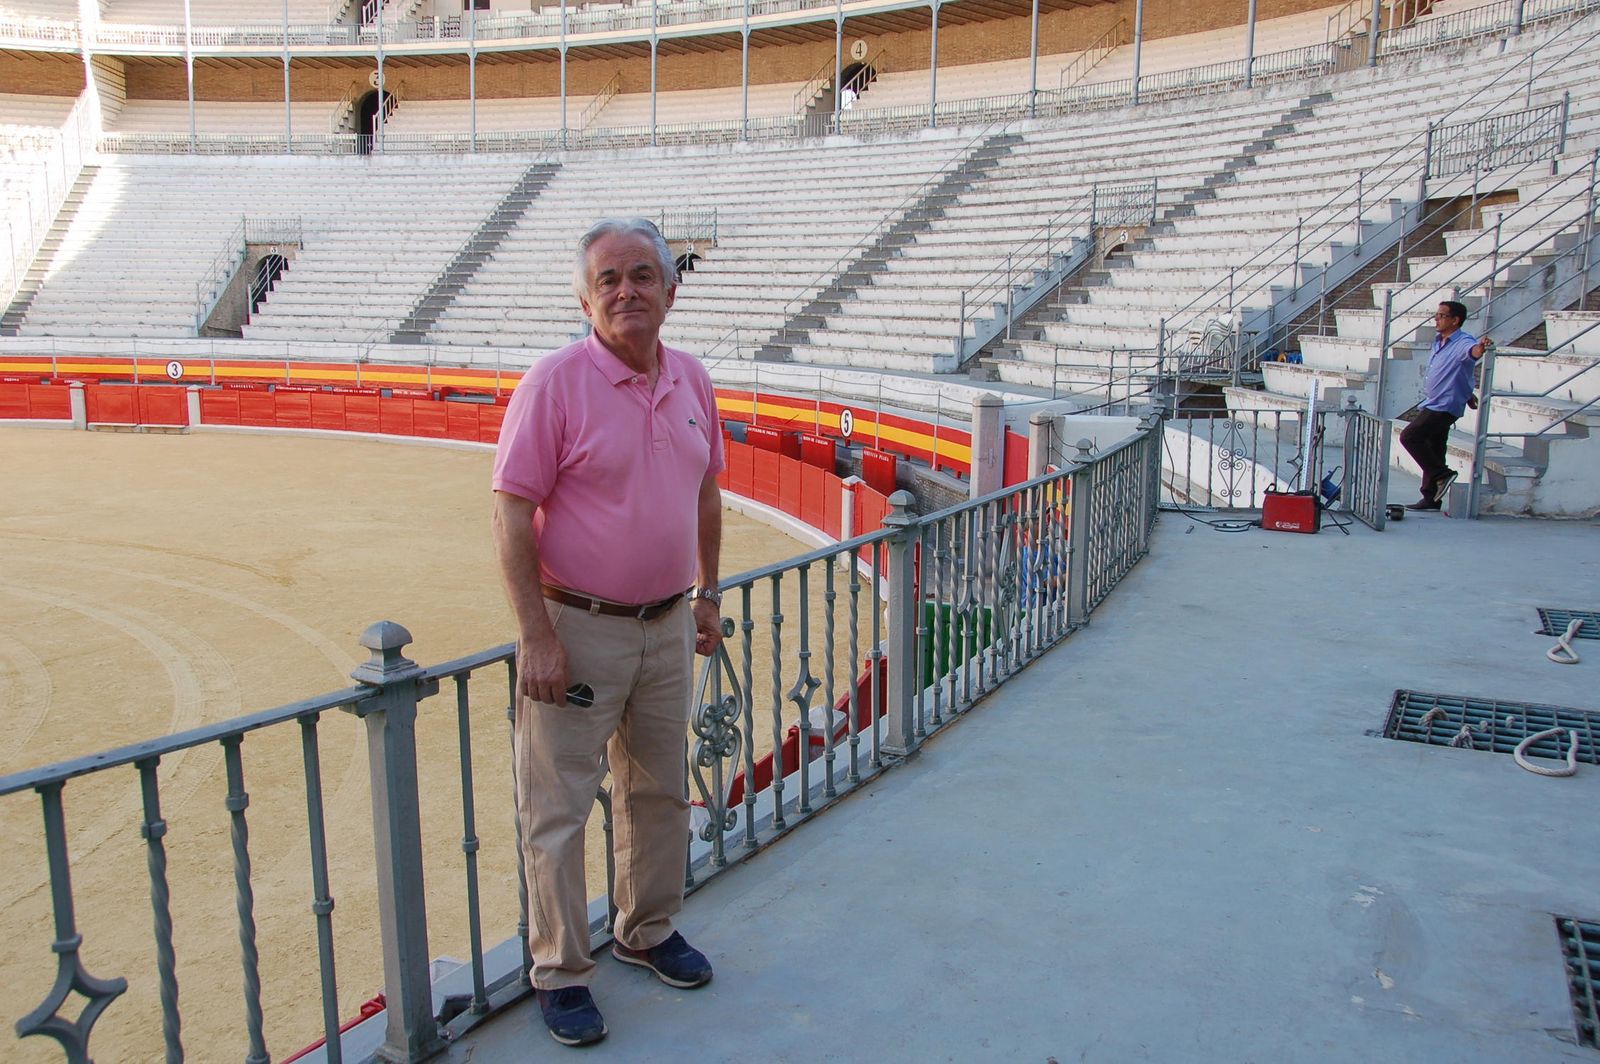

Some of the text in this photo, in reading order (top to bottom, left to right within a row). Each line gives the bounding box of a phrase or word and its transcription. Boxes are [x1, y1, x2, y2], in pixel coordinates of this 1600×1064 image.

[856, 43, 862, 57] 4
[171, 363, 178, 377] 3
[843, 413, 849, 432] 5
